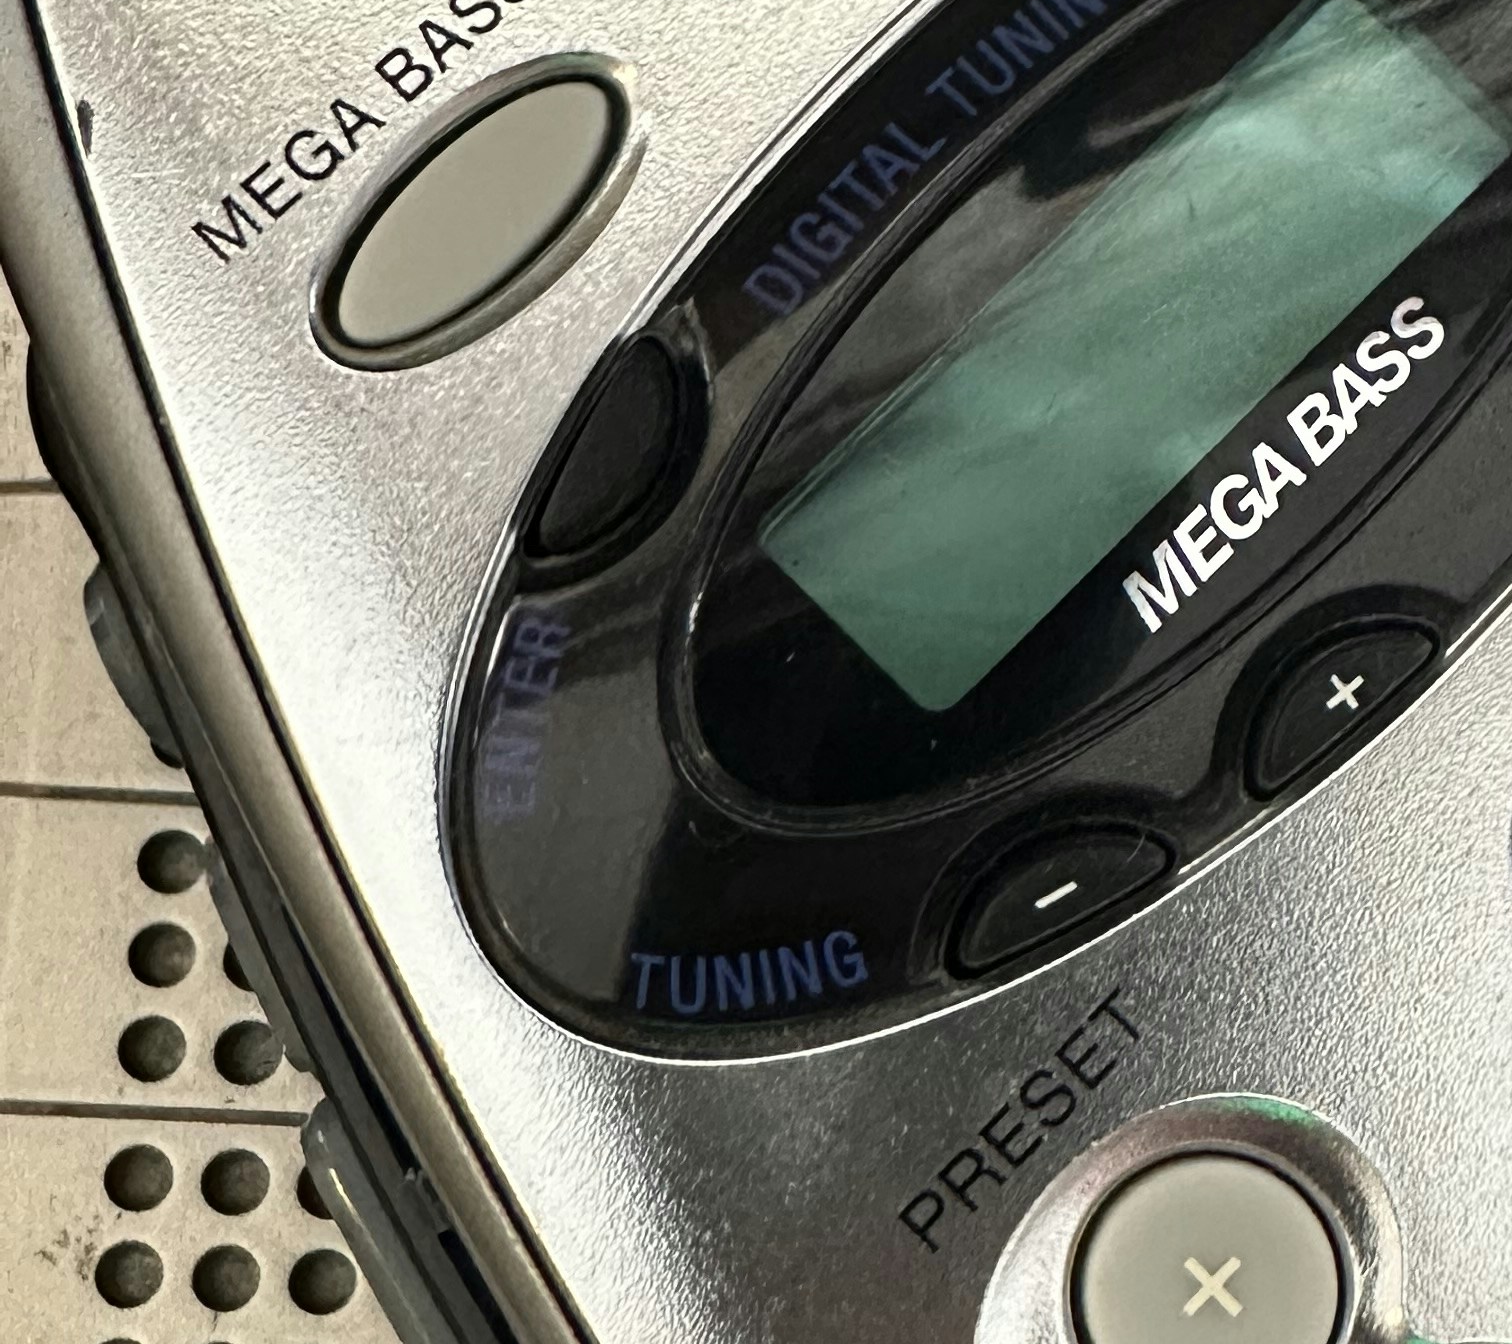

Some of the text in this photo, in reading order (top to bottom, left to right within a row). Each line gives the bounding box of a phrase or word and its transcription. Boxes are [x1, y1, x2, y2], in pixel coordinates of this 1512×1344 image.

[190, 97, 387, 265] MEGA
[742, 122, 948, 317] DIGITAL
[1121, 296, 1445, 633] MEGA BASS
[482, 616, 571, 821] ENTER
[630, 930, 869, 1014] TUNING
[897, 985, 1140, 1254] PRESET
